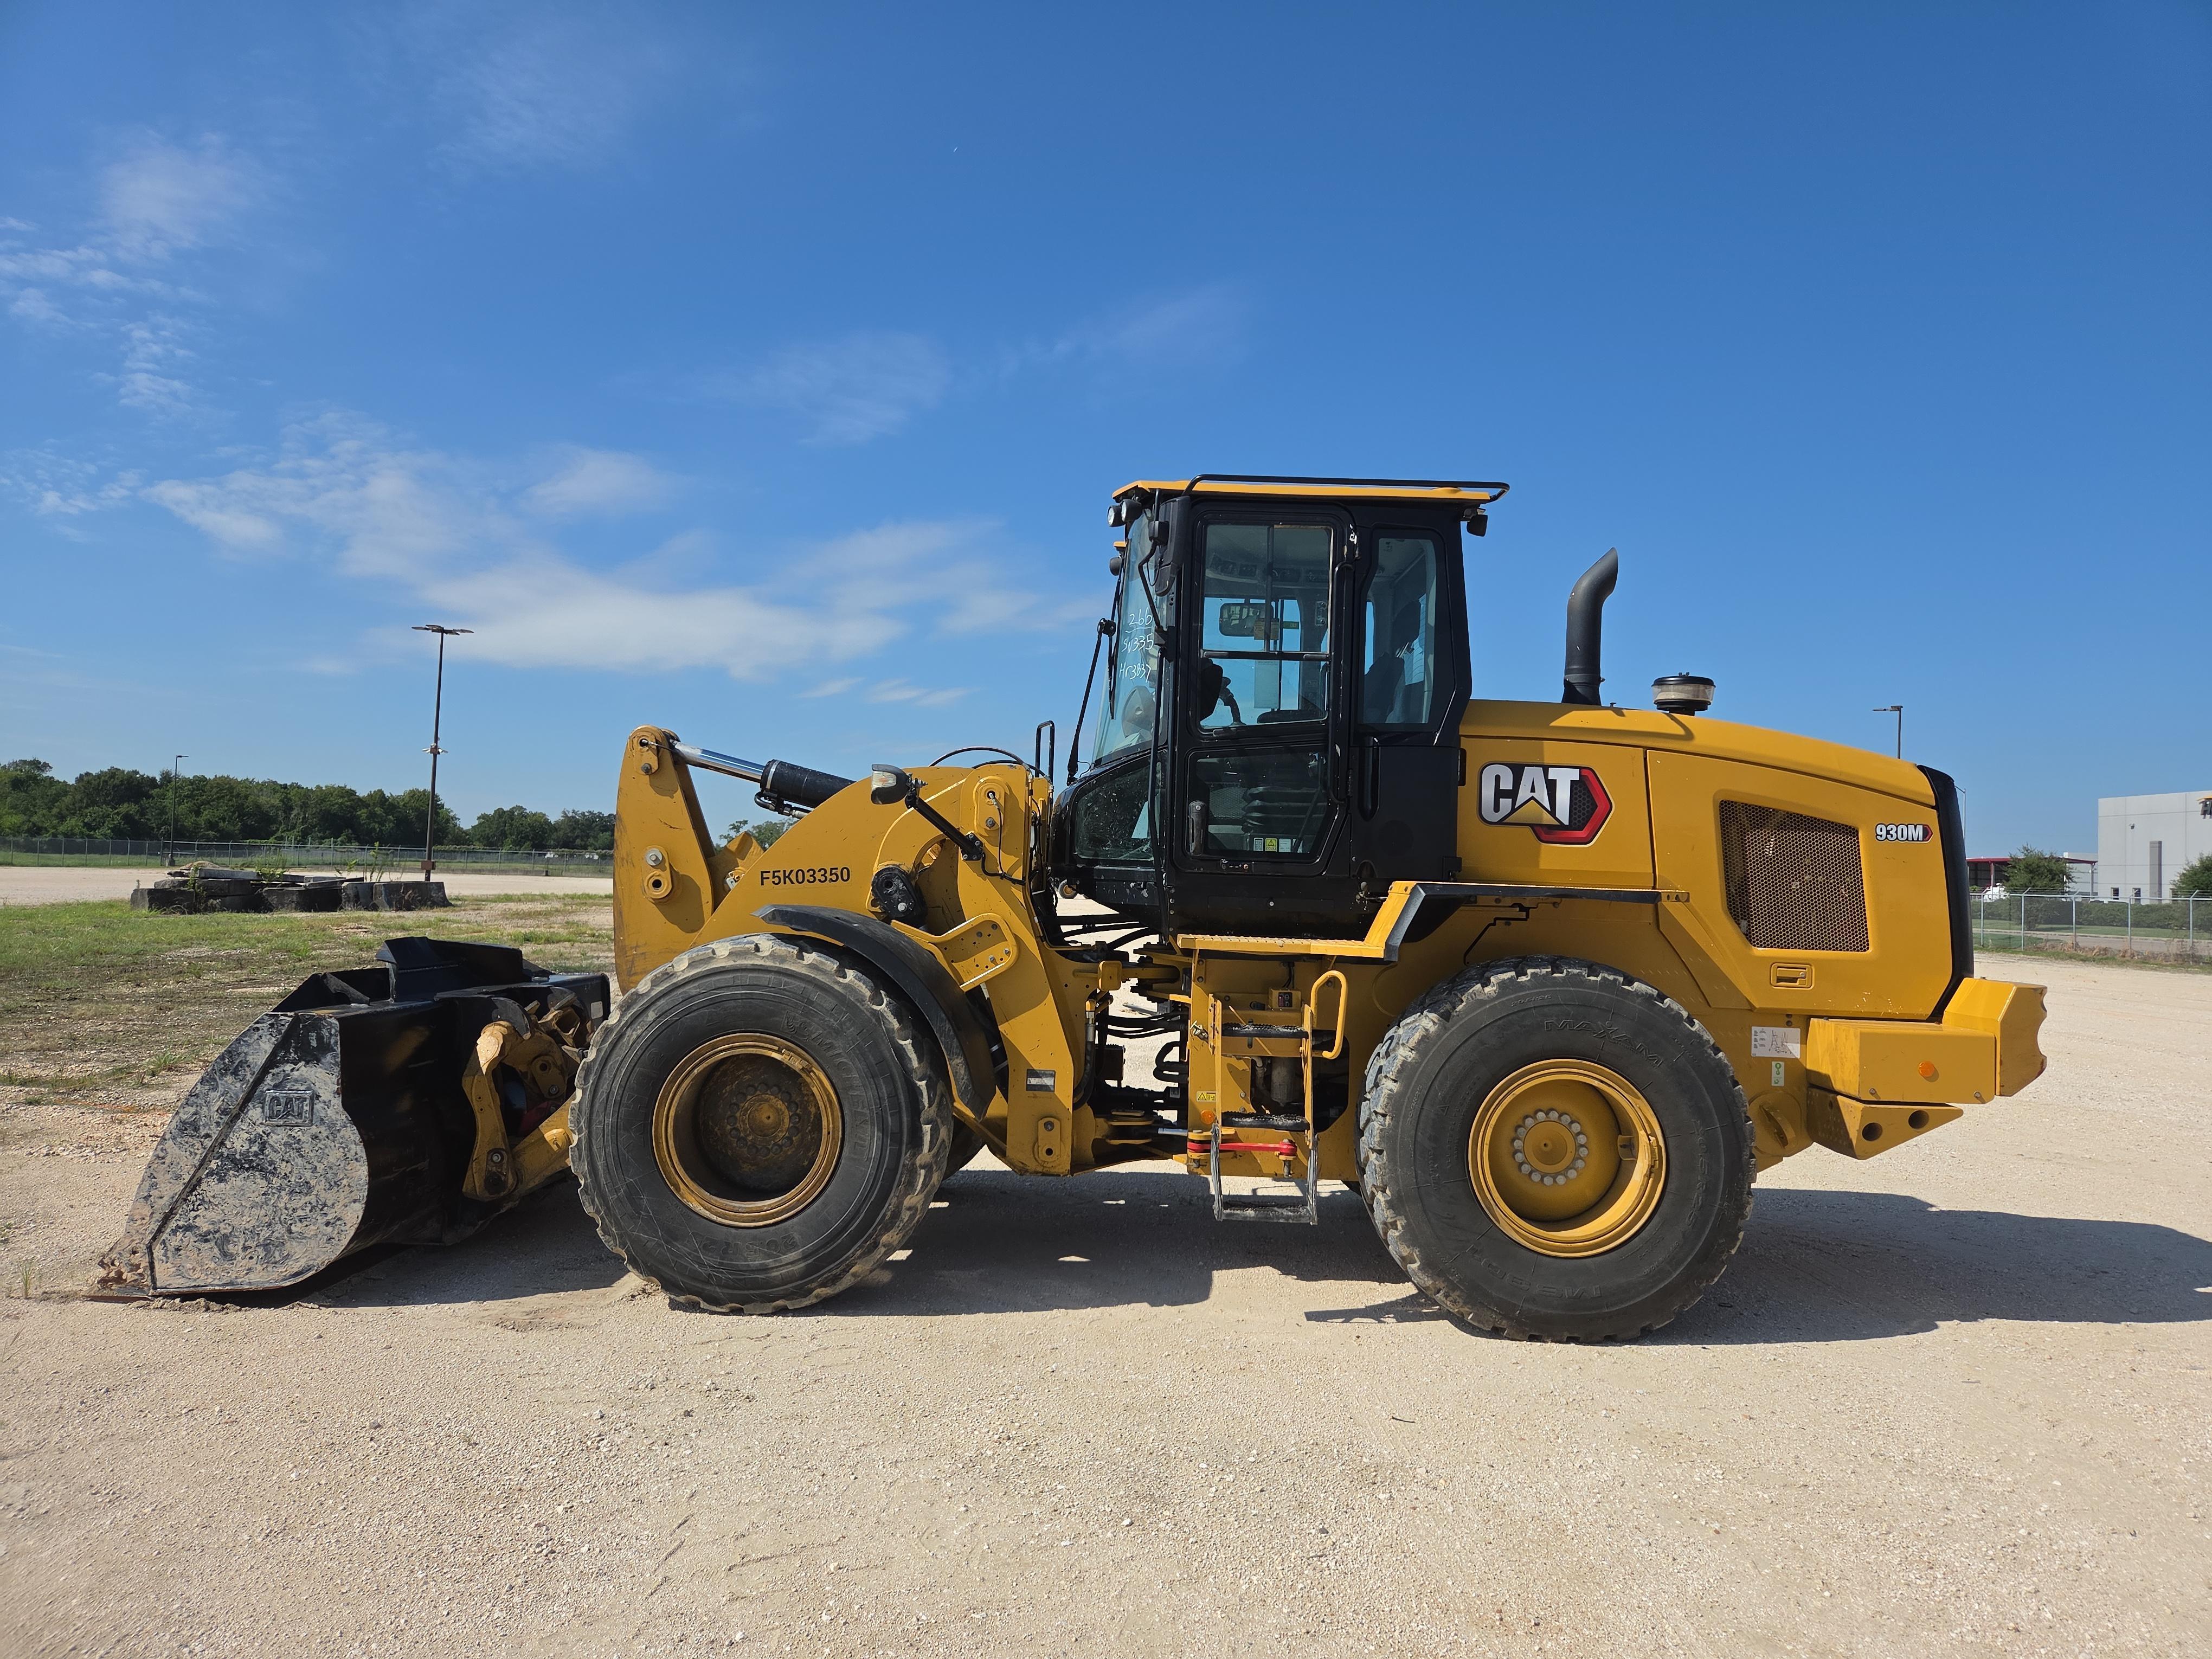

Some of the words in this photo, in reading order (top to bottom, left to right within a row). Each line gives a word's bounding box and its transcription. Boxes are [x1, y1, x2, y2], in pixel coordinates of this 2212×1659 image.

[1129, 607, 1153, 626] 266
[1481, 764, 1580, 825] CAT
[1876, 824, 1923, 841] 930M
[760, 867, 850, 886] F5K03350
[268, 1095, 307, 1121] CAT
